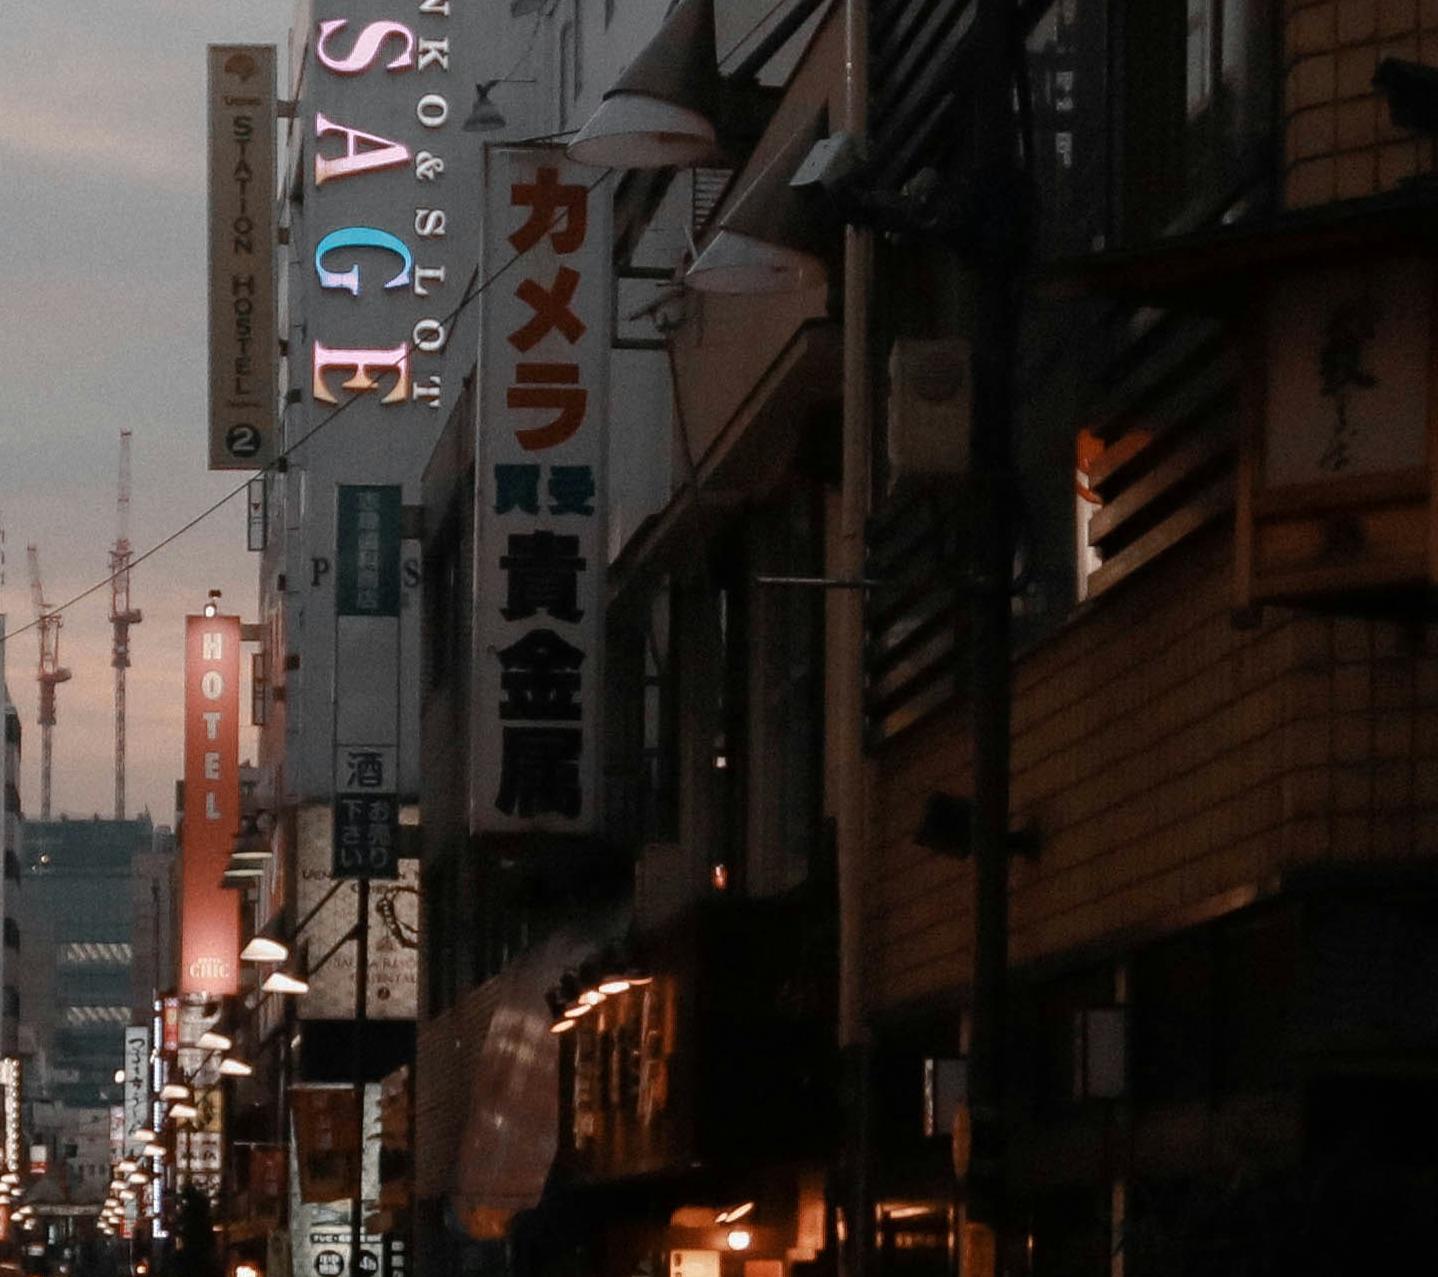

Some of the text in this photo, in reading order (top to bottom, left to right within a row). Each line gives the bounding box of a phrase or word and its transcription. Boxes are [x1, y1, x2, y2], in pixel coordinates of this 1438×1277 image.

[232, 115, 255, 254] STATION
[232, 275, 255, 395] HOSTEL
[506, 167, 588, 451] カメラ
[202, 629, 224, 821] HOTEL
[494, 530, 588, 818] 貴金属
[346, 751, 383, 788] 酒
